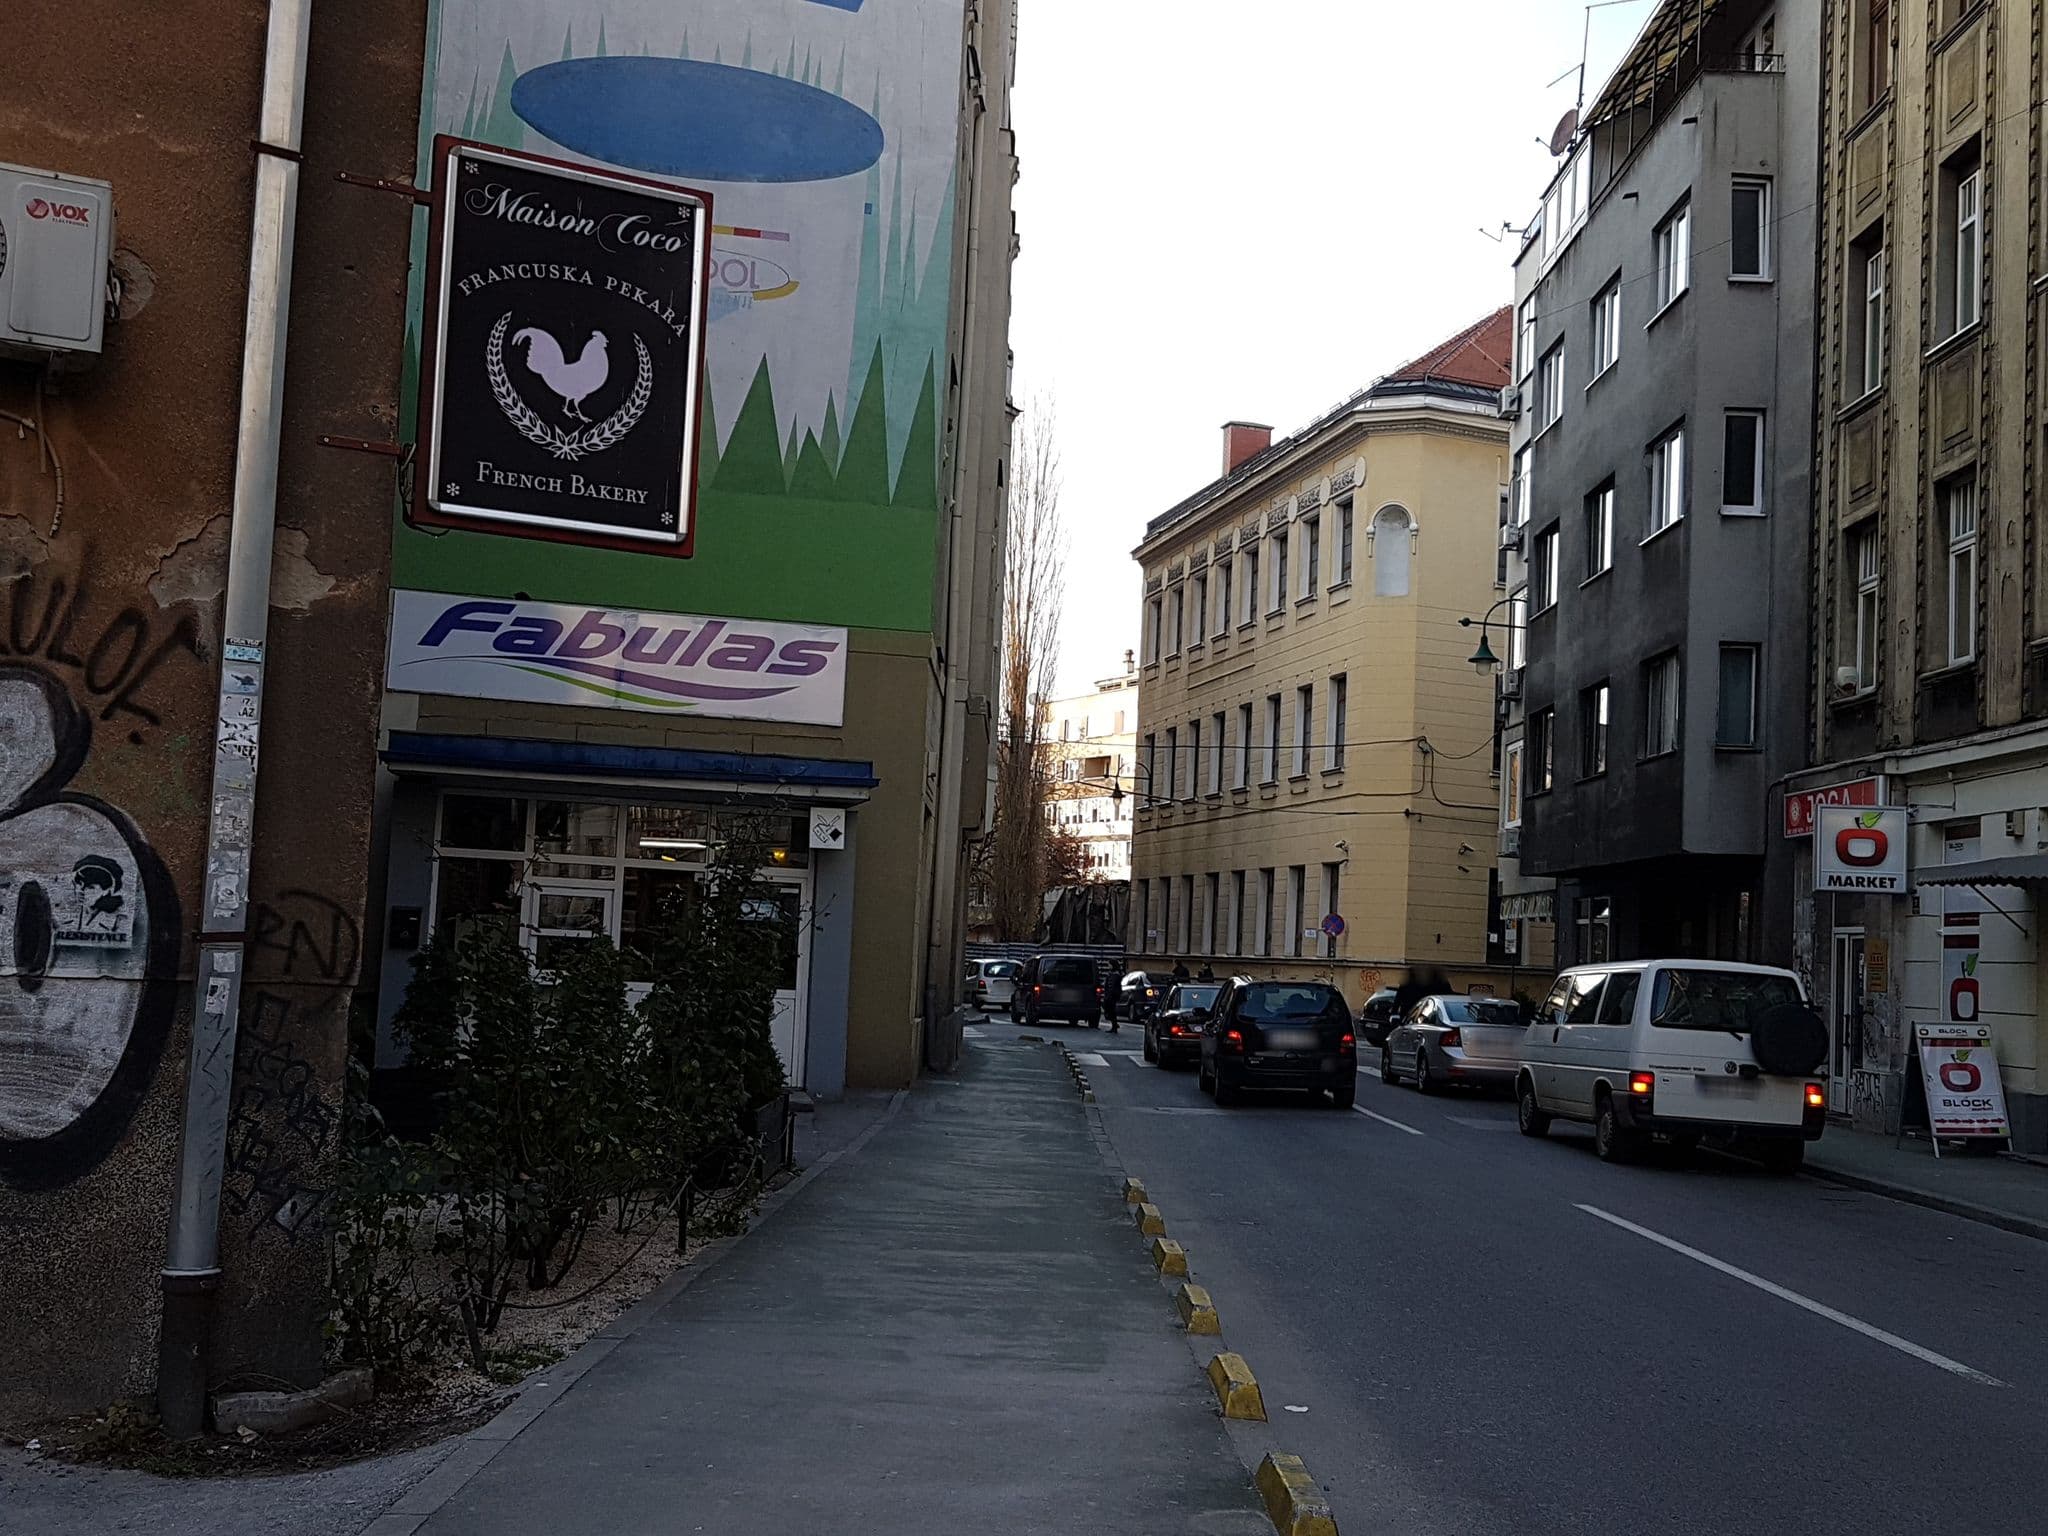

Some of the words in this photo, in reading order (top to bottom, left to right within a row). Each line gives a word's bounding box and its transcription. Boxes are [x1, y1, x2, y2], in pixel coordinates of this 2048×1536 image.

[50, 203, 89, 223] VOX
[464, 183, 597, 237] Maison
[597, 214, 690, 253] Coco
[457, 263, 595, 298] FRANCUSKA
[605, 276, 687, 339] PEKARA
[476, 461, 563, 494] FRENCH
[569, 474, 649, 504] BAKERY
[417, 600, 841, 677] Fabulas
[1828, 875, 1898, 888] MARKET
